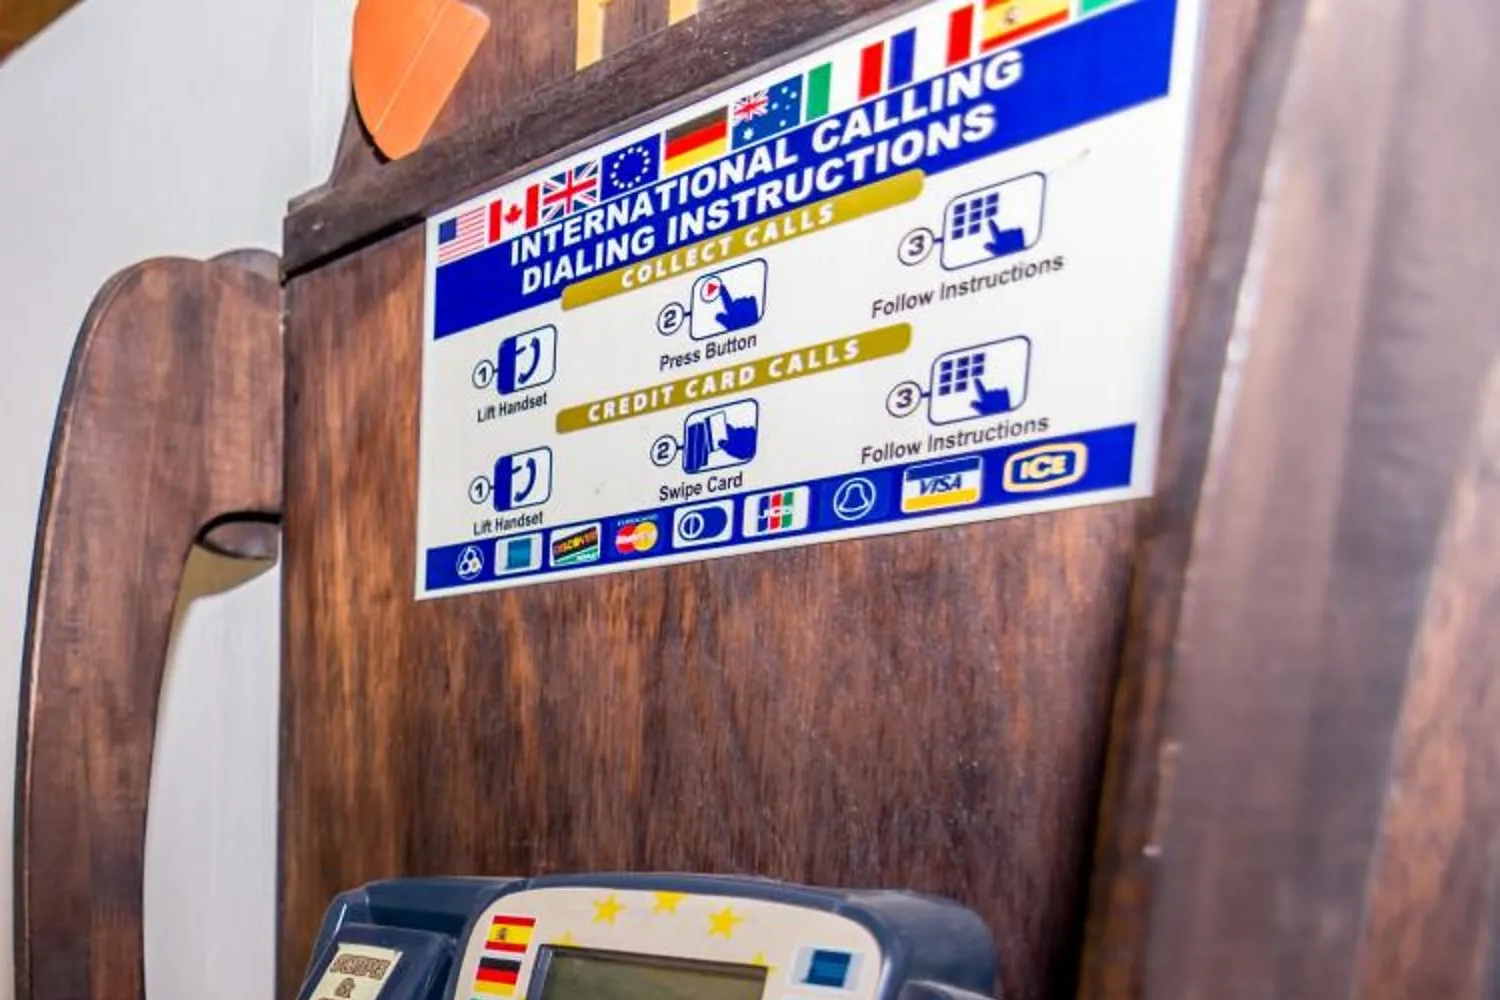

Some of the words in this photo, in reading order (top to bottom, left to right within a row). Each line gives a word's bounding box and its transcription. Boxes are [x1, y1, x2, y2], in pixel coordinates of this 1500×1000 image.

[511, 138, 798, 266] INTERNATIONAL
[812, 50, 1023, 153] CALLING
[522, 226, 654, 295] DIALING
[667, 104, 996, 246] INSTRUCTIONS
[621, 239, 732, 288] COLLECT
[744, 204, 833, 247] CALLS
[907, 235, 926, 250] 3
[871, 289, 933, 319] Follow
[940, 255, 1064, 301] Instructions
[664, 310, 677, 328] 2
[659, 350, 700, 371] Press
[705, 334, 757, 359] Button
[588, 386, 673, 422] CREDIT
[685, 365, 756, 398] CARD
[768, 340, 860, 379] CALLS
[477, 403, 496, 423] Lift
[499, 393, 547, 418] Handset
[896, 388, 913, 409] 3
[658, 441, 670, 459] 2
[861, 439, 922, 464] Follow
[927, 416, 1050, 452] Instructions
[1020, 455, 1067, 480] ICE
[659, 481, 701, 501] Swipe
[707, 472, 743, 493] Card
[918, 474, 962, 496] VISA
[473, 518, 492, 536] Lift
[495, 511, 543, 531] Handset
